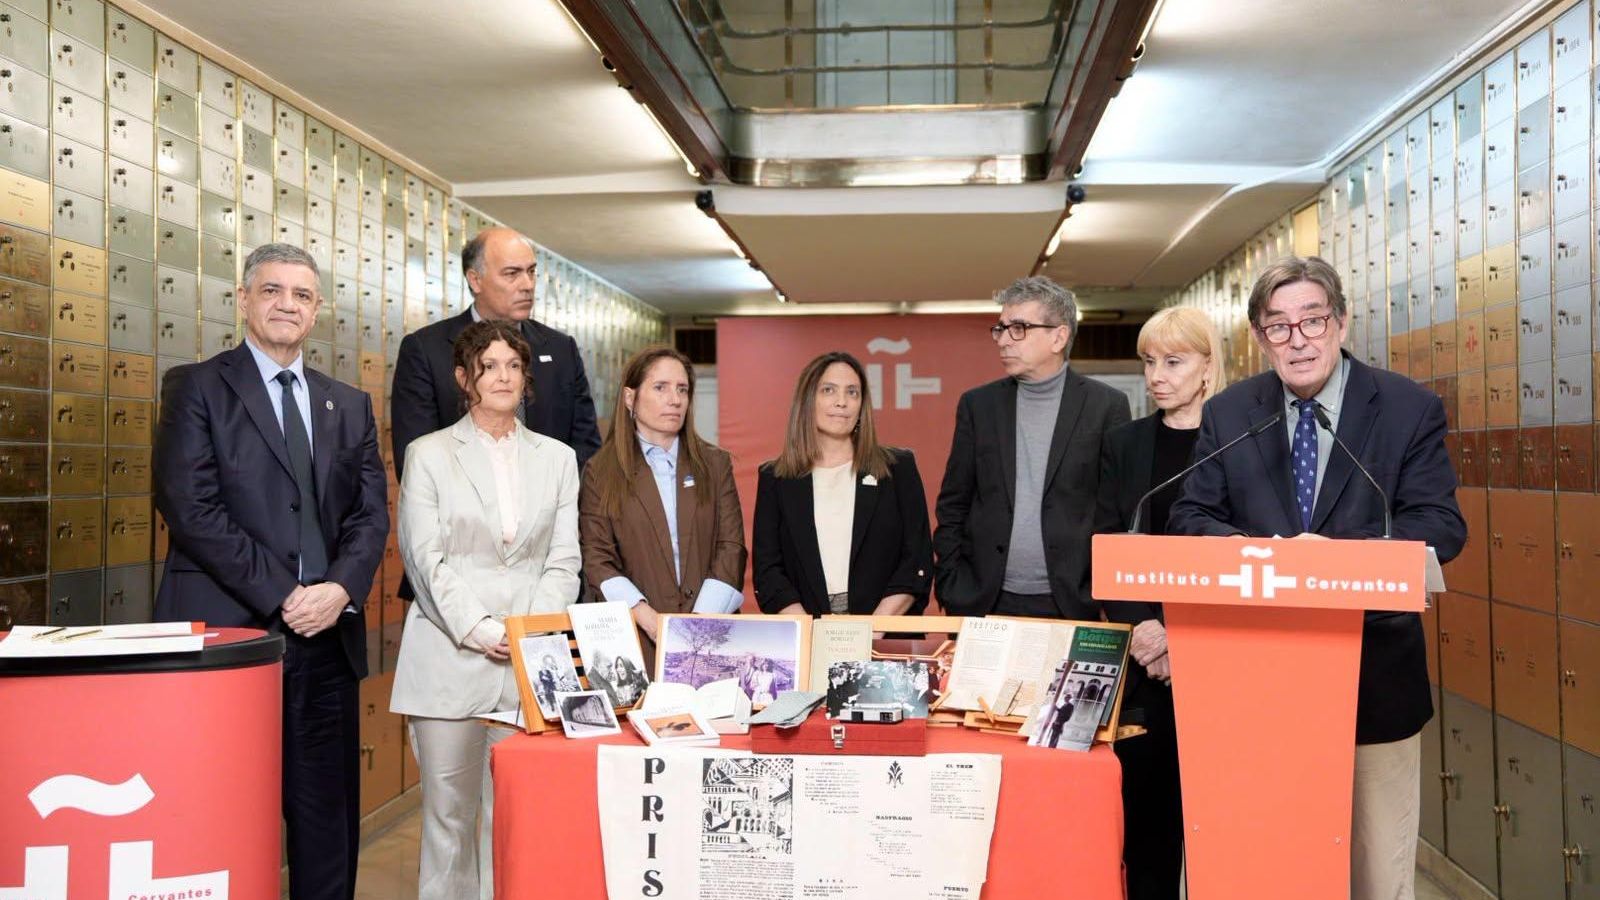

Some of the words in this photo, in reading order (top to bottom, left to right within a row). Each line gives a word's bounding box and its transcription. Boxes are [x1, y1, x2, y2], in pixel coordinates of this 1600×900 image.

[1116, 571, 1210, 586] Instituto
[1305, 576, 1408, 592] Cervantes
[968, 620, 1008, 631] TESTIGO
